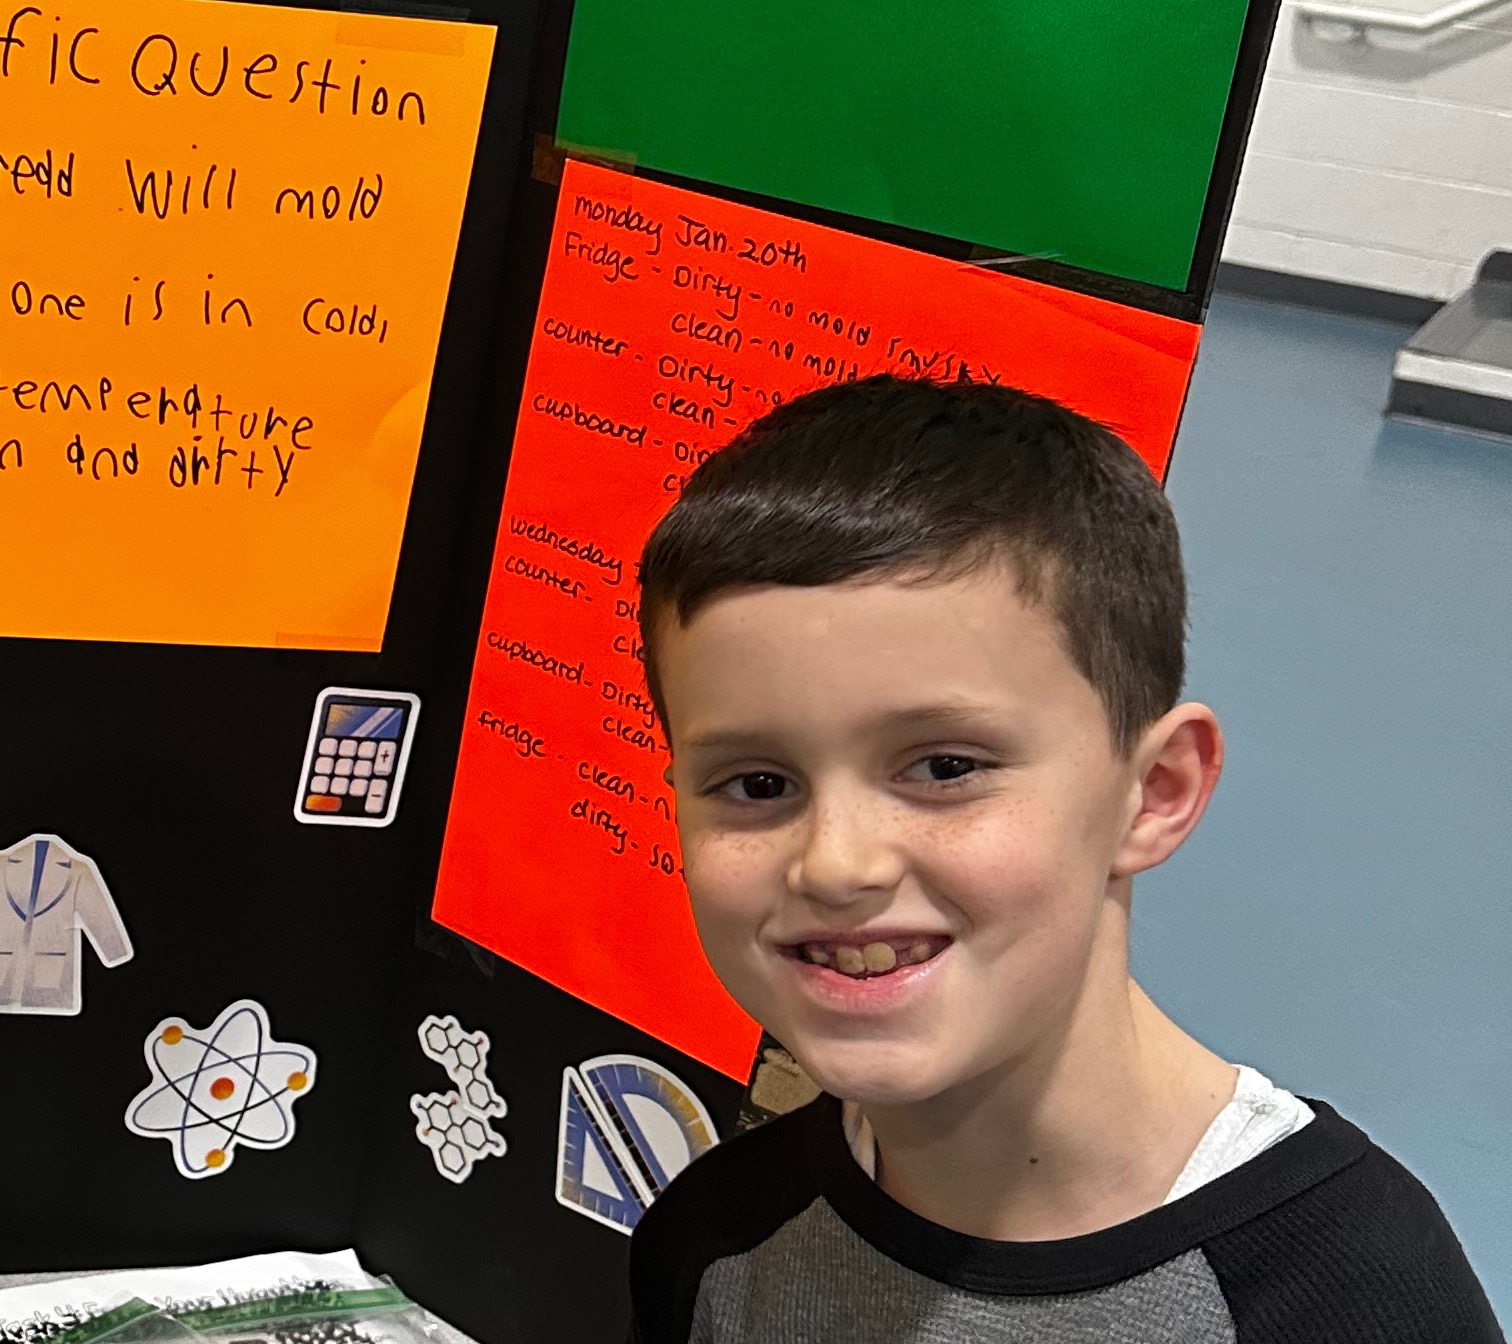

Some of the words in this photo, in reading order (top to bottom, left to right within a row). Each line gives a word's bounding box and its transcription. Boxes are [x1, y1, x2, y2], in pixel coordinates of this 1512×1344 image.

[131, 34, 425, 125] Question
[275, 173, 383, 222] mold
[676, 214, 736, 255] Jan.
[737, 238, 807, 273] 20th
[11, 281, 86, 321] one
[124, 276, 165, 326] is
[204, 273, 252, 327] in
[770, 299, 794, 318] no
[808, 311, 871, 346] mold
[769, 340, 794, 361] no
[66, 434, 139, 480] and
[169, 435, 295, 497] dirty
